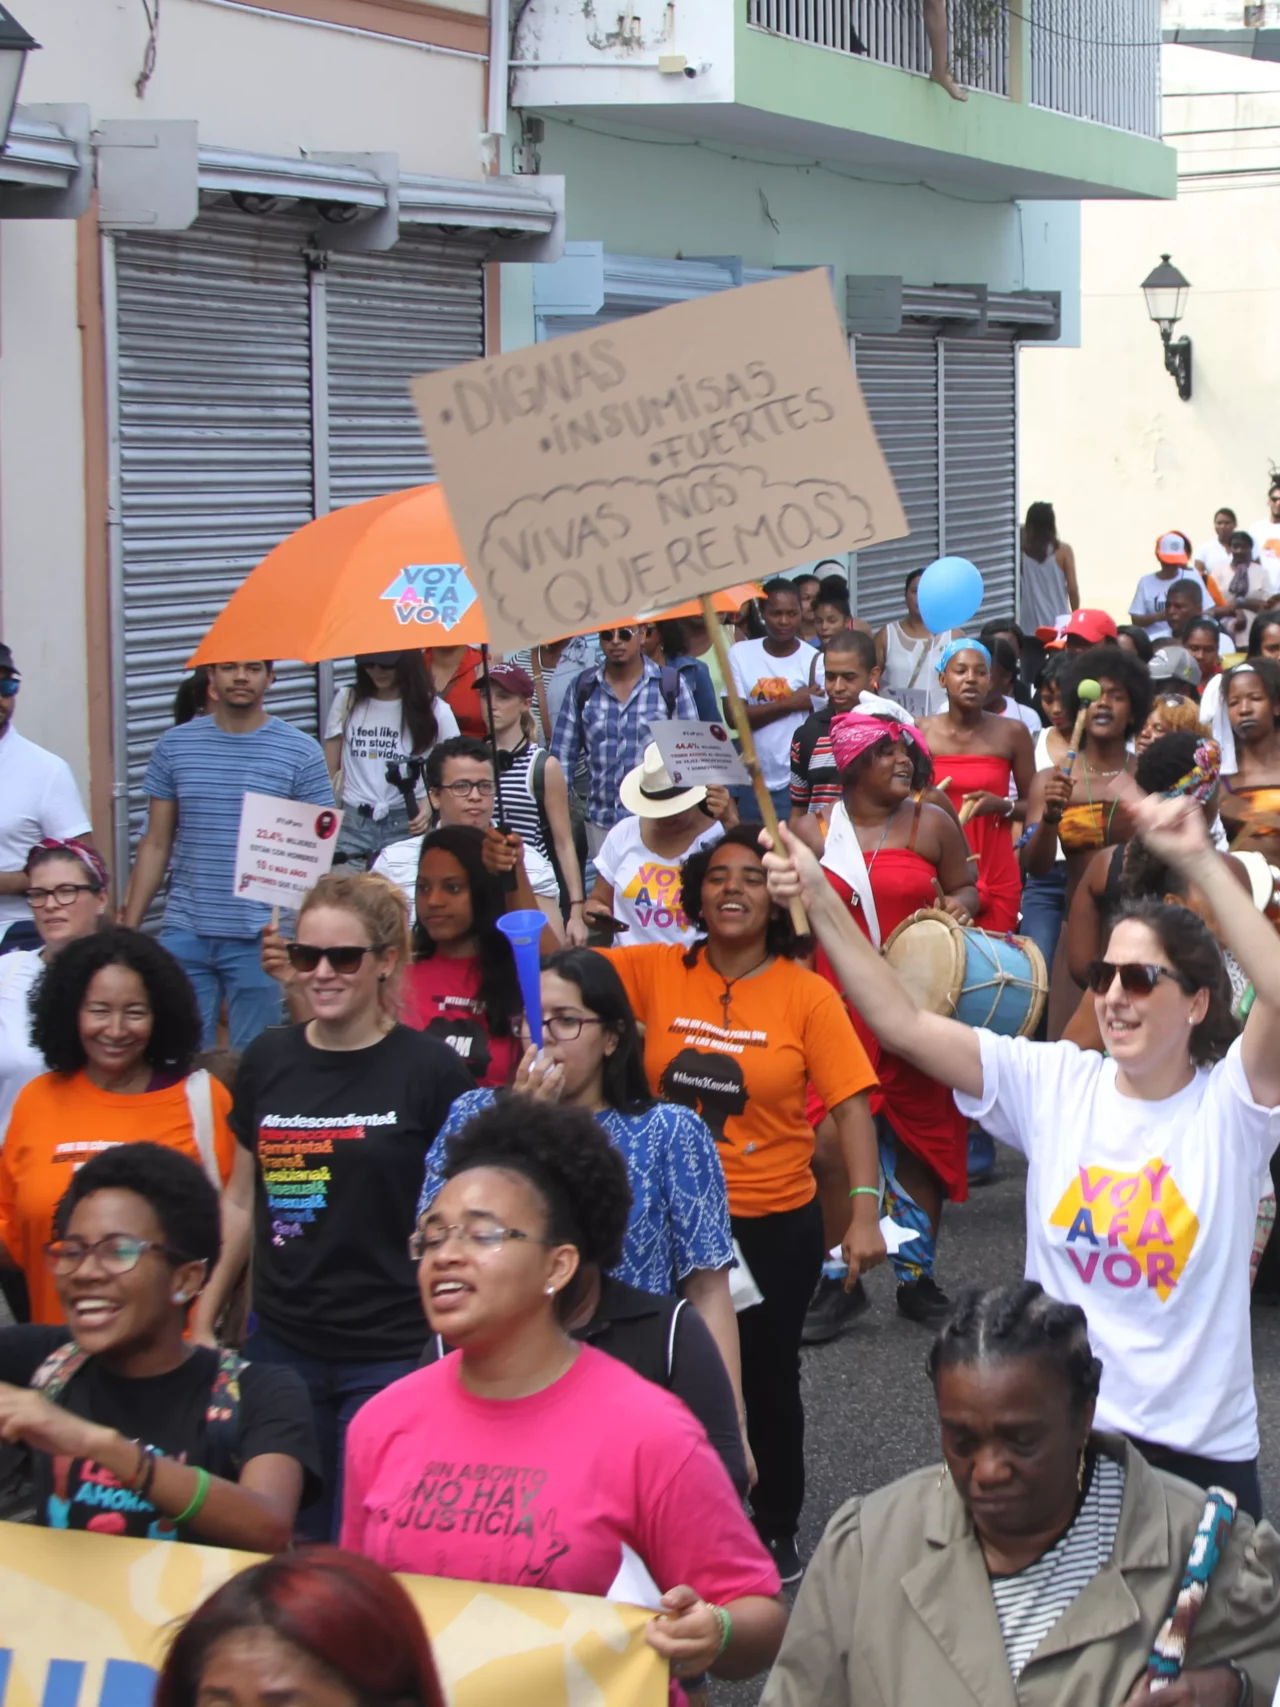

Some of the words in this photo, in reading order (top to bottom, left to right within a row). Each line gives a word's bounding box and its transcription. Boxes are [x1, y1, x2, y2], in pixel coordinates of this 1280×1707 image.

[651, 386, 835, 468] FUERTES
[499, 504, 631, 573] VIVAS
[655, 473, 739, 525] NOS
[544, 492, 845, 626] QUEREMOS
[402, 567, 463, 585] VOY
[395, 605, 459, 624] VOR
[357, 726, 379, 737] feel
[380, 726, 399, 738] like
[369, 738, 397, 750] stuck
[639, 866, 684, 887] VO
[1079, 1164, 1172, 1209] VOY
[1065, 1247, 1179, 1289] VOR
[423, 1460, 455, 1479] SIN
[458, 1463, 548, 1487] ABORTO
[411, 1479, 463, 1507] NO
[471, 1483, 541, 1511] HAY
[396, 1505, 534, 1539] JUSTICIA
